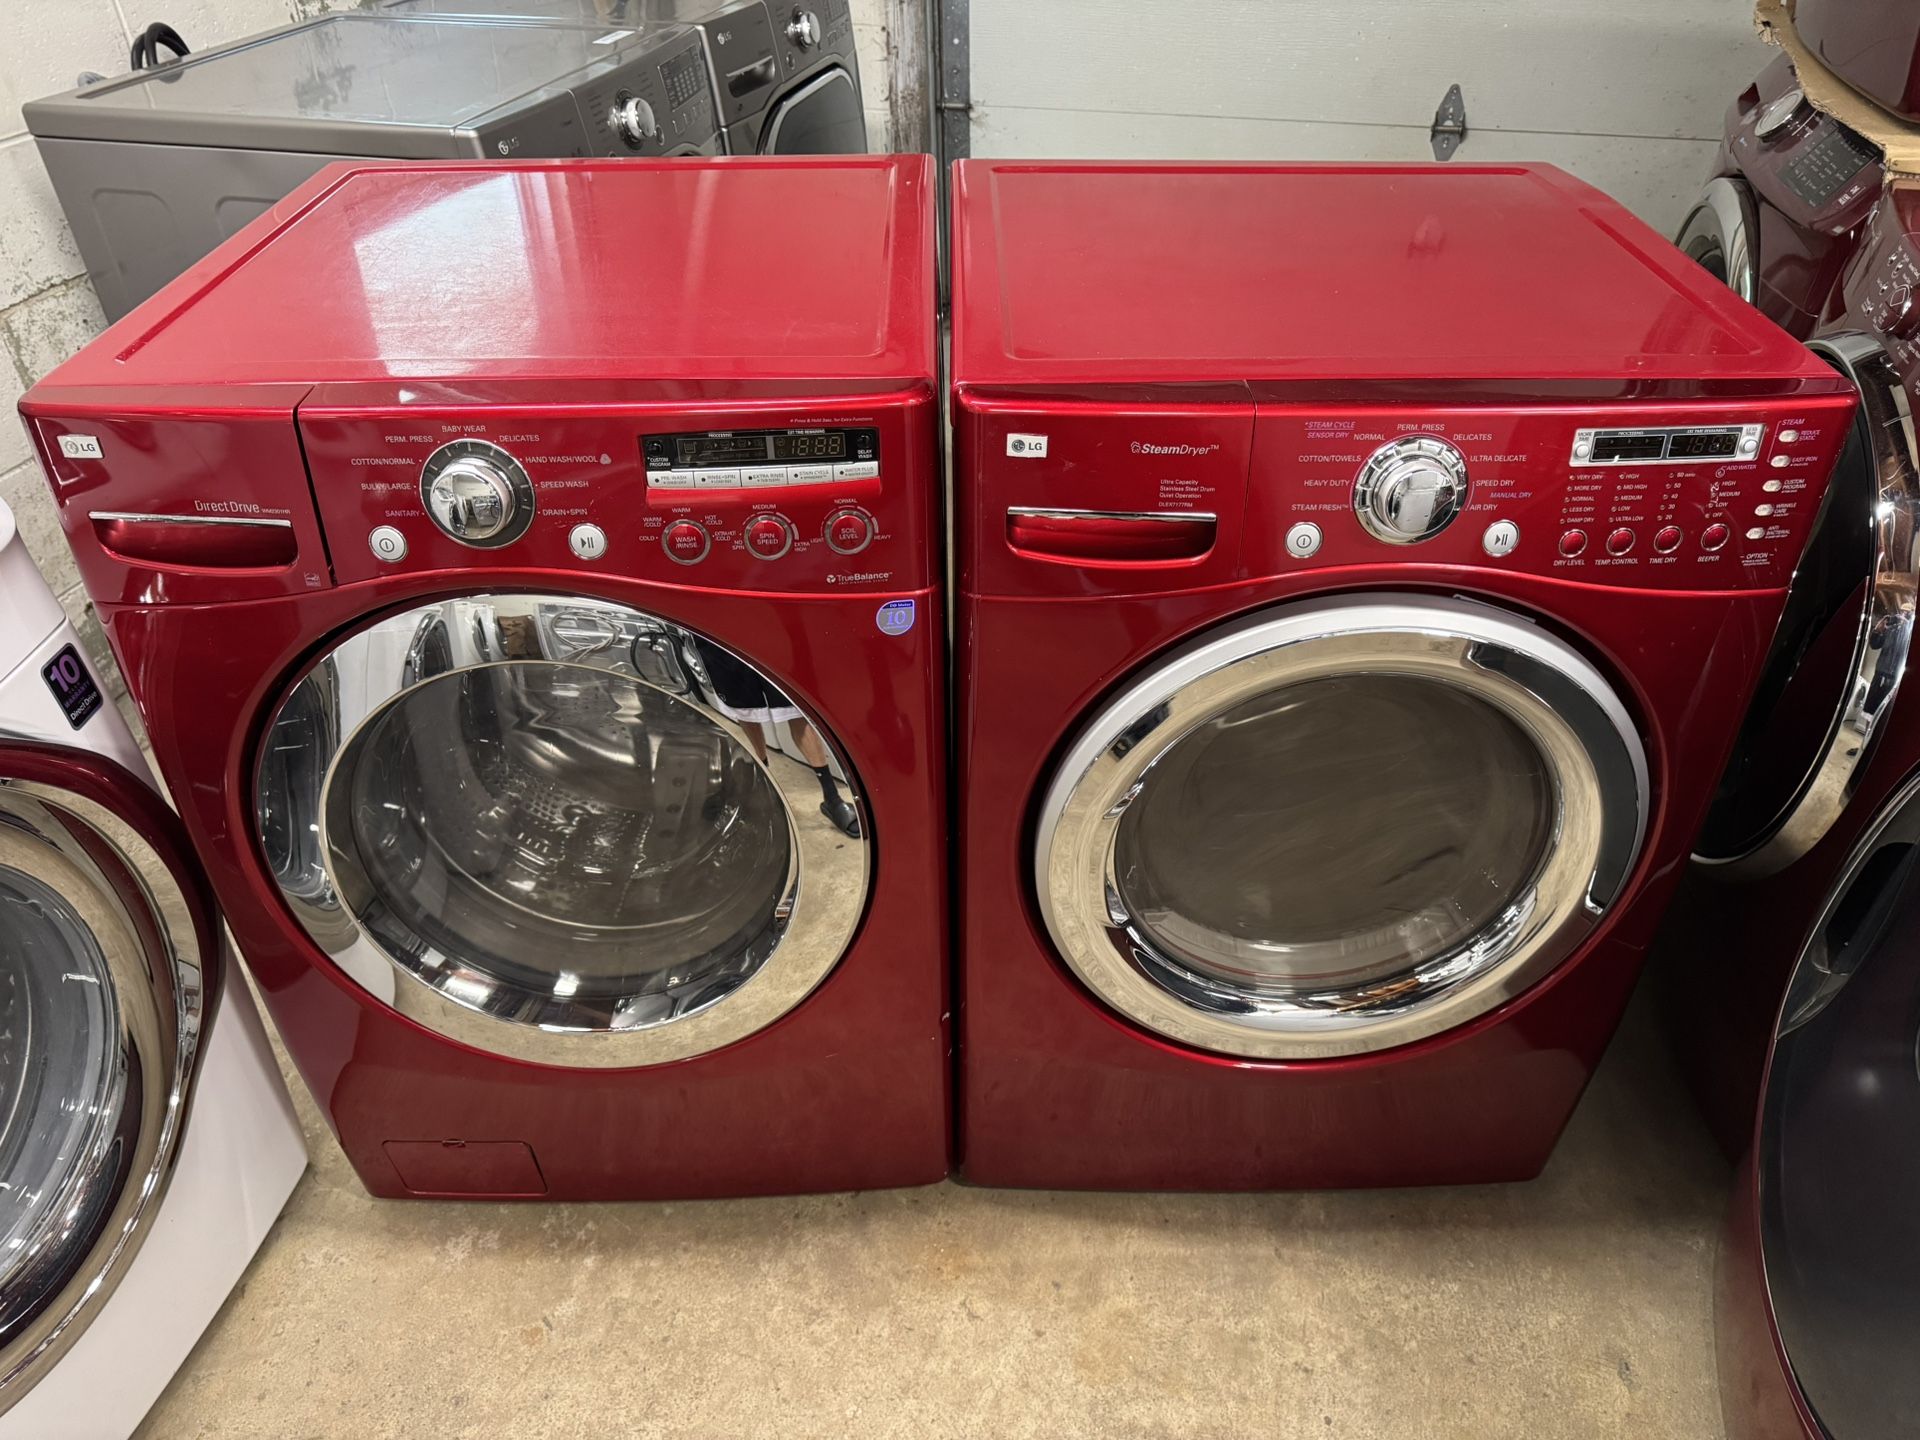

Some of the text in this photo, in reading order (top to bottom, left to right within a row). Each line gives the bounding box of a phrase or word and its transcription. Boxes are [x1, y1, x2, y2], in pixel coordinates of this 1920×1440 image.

[1334, 421, 1355, 429] CYCLE
[1781, 418, 1805, 426] STEAM
[442, 425, 486, 433] BABY WEAR
[409, 435, 433, 443] PRESS
[499, 434, 540, 442] DELICATES
[1307, 431, 1333, 439] SENSOR
[1353, 433, 1386, 441] NORMAL
[1453, 433, 1492, 441] DELICATES
[80, 442, 96, 452] LG
[1028, 442, 1043, 451] LG
[351, 457, 415, 466] COTTON/NORMAL
[525, 455, 598, 464] HAND WASH/WOOL
[361, 482, 412, 491] BULKY/LARGE
[385, 510, 420, 518] SANITARY
[886, 610, 906, 626] 10
[49, 654, 81, 693] 10
[70, 702, 85, 721] Direct
[84, 691, 98, 706] Drive
